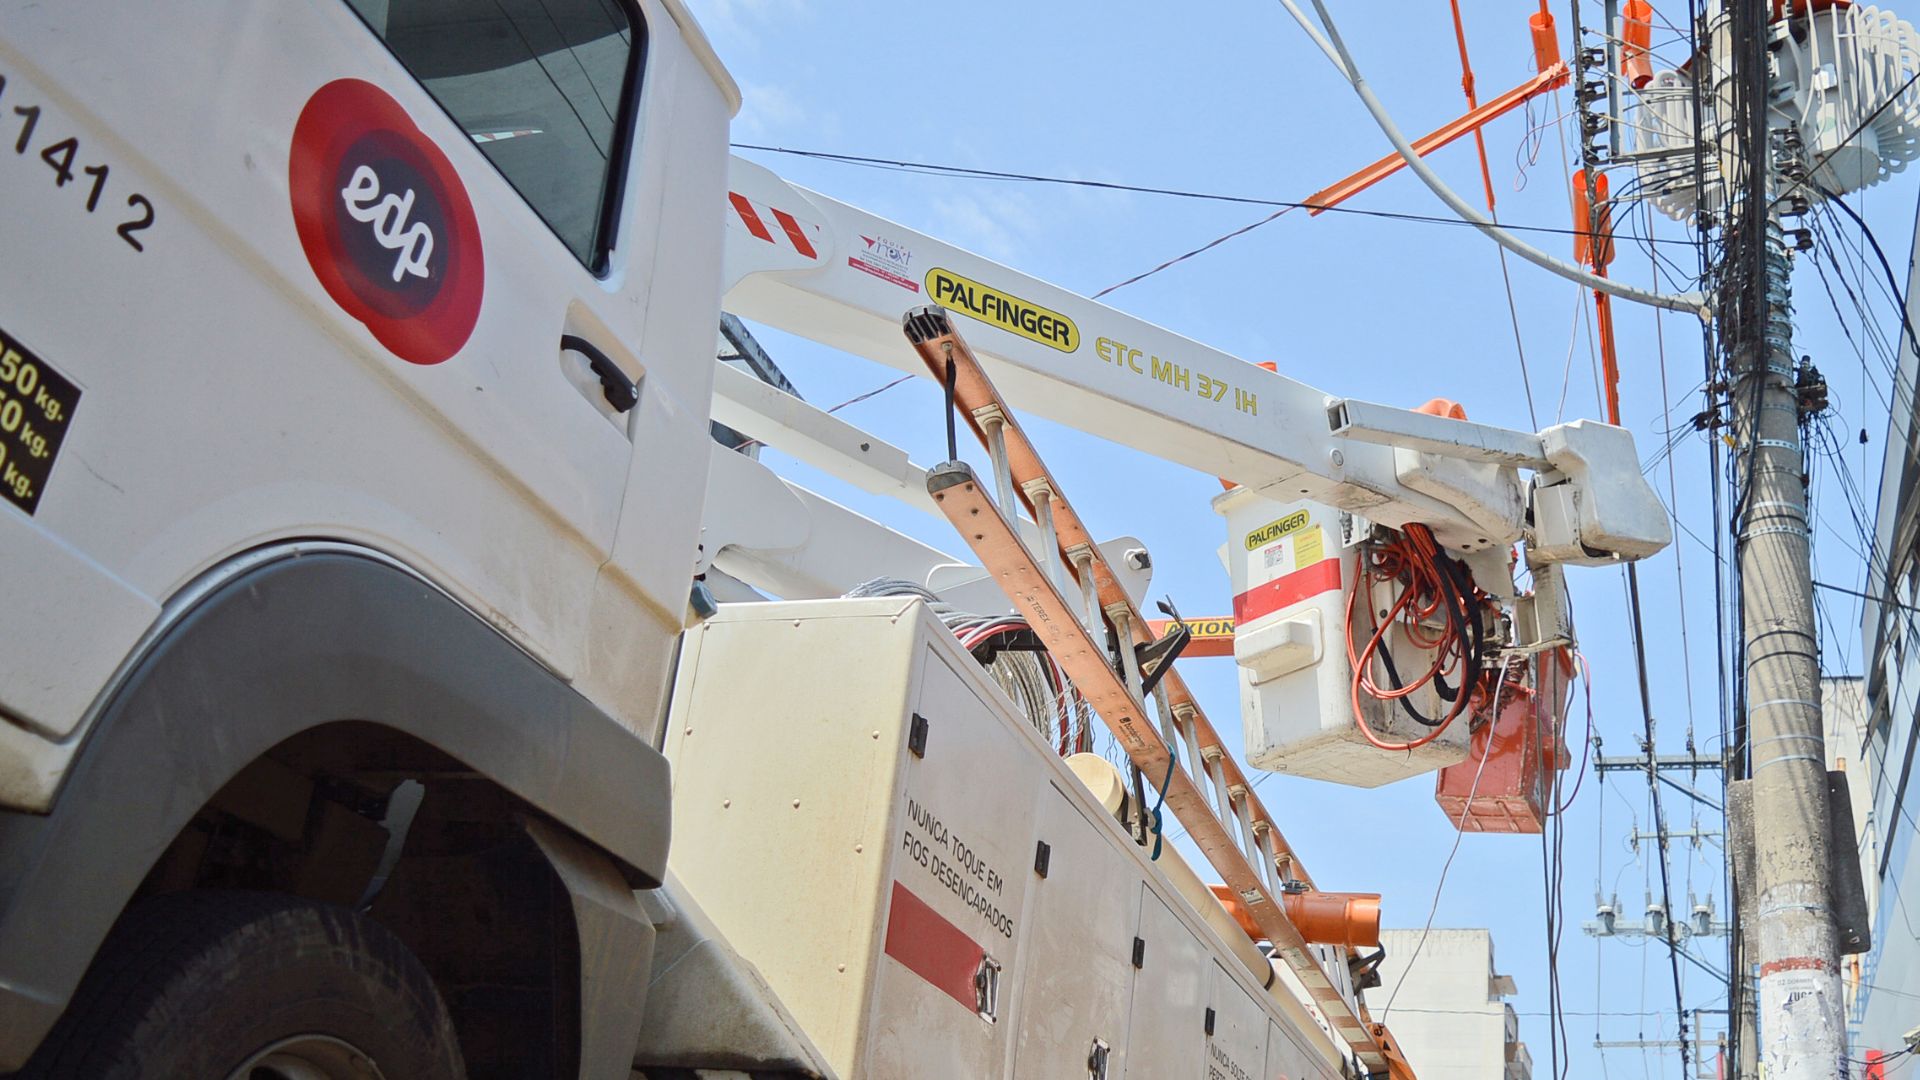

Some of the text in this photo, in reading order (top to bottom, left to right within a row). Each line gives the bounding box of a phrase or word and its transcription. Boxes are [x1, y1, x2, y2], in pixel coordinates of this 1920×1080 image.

[342, 165, 434, 282] edp
[935, 274, 1070, 347] PALFINGER
[1095, 336, 1258, 416] ETC MH 37 IH
[1248, 513, 1306, 548] PALFINGER
[902, 830, 1014, 939] FIOS DESENCAPADOS
[908, 799, 1003, 897] NUNCA TOQUE EM
[1211, 1042, 1230, 1071] NUNCA
